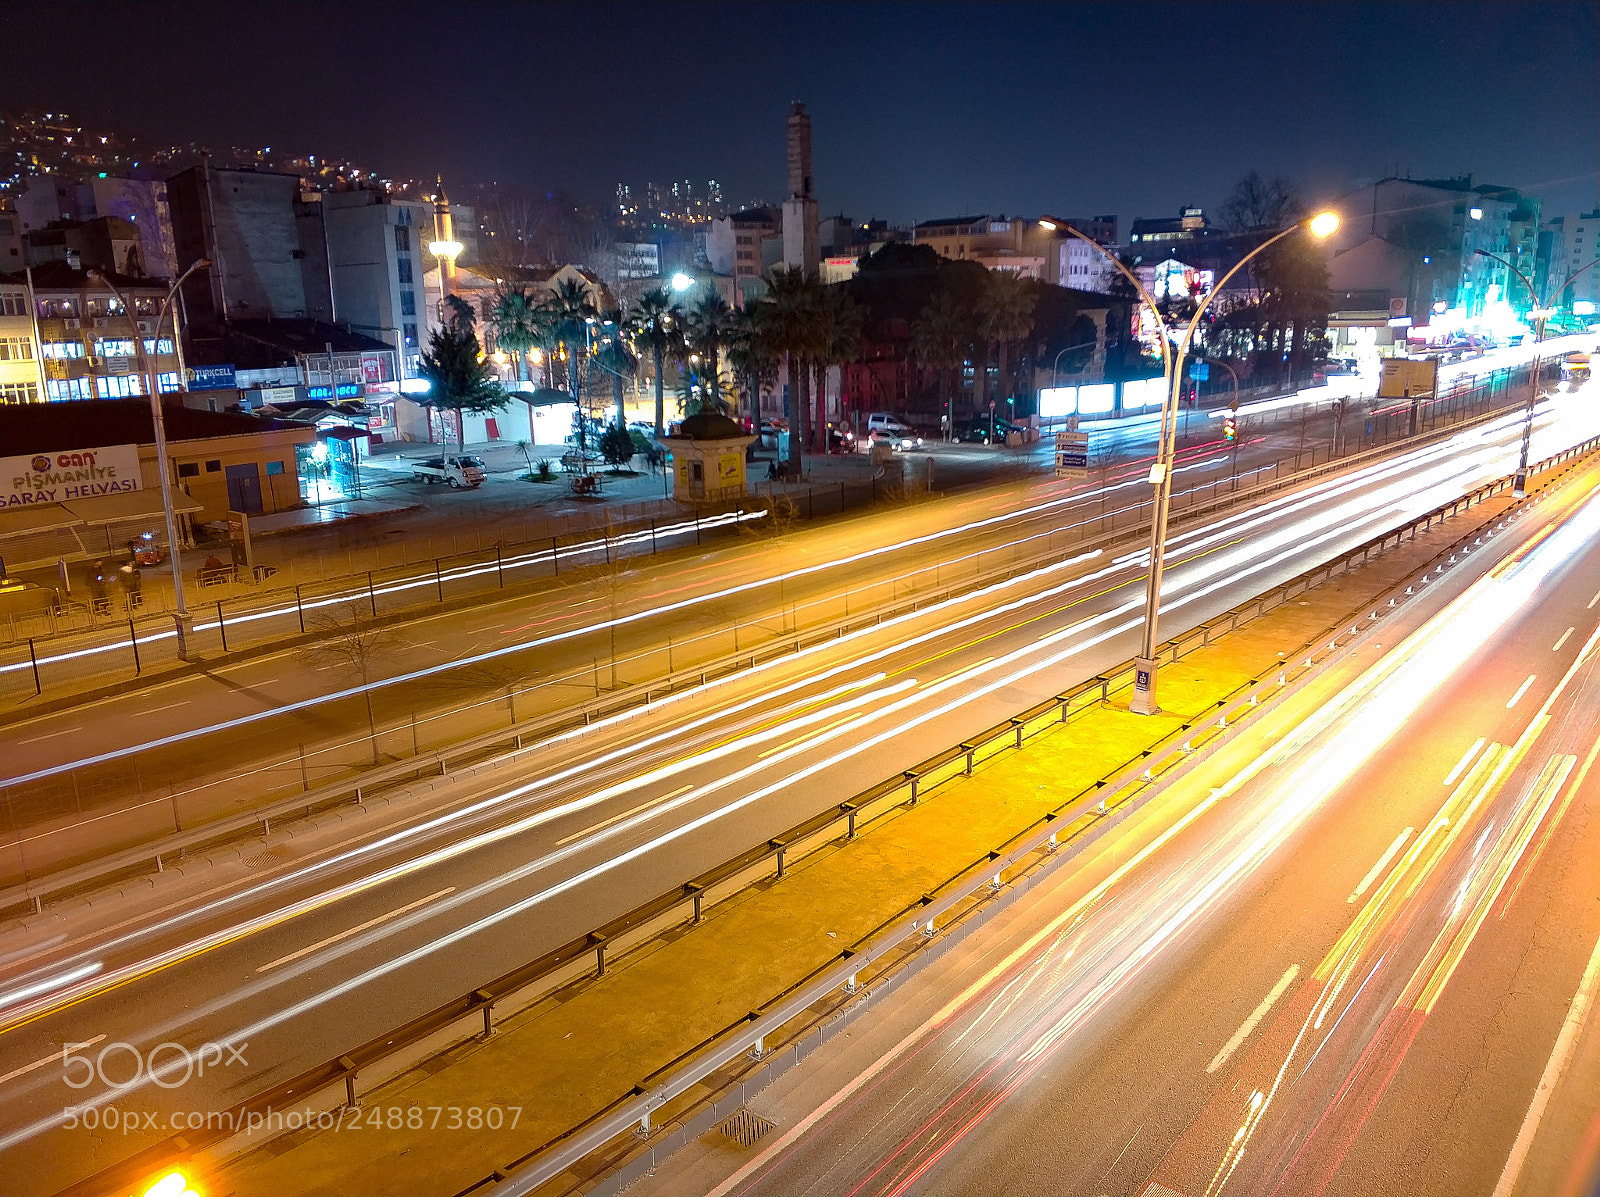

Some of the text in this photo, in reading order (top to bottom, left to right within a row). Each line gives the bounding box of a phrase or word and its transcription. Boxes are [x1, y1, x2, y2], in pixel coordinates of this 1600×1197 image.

[195, 368, 233, 378] TURKCELL
[12, 465, 118, 490] PİŞMANİYE
[0, 478, 138, 508] SARAY HELVASI
